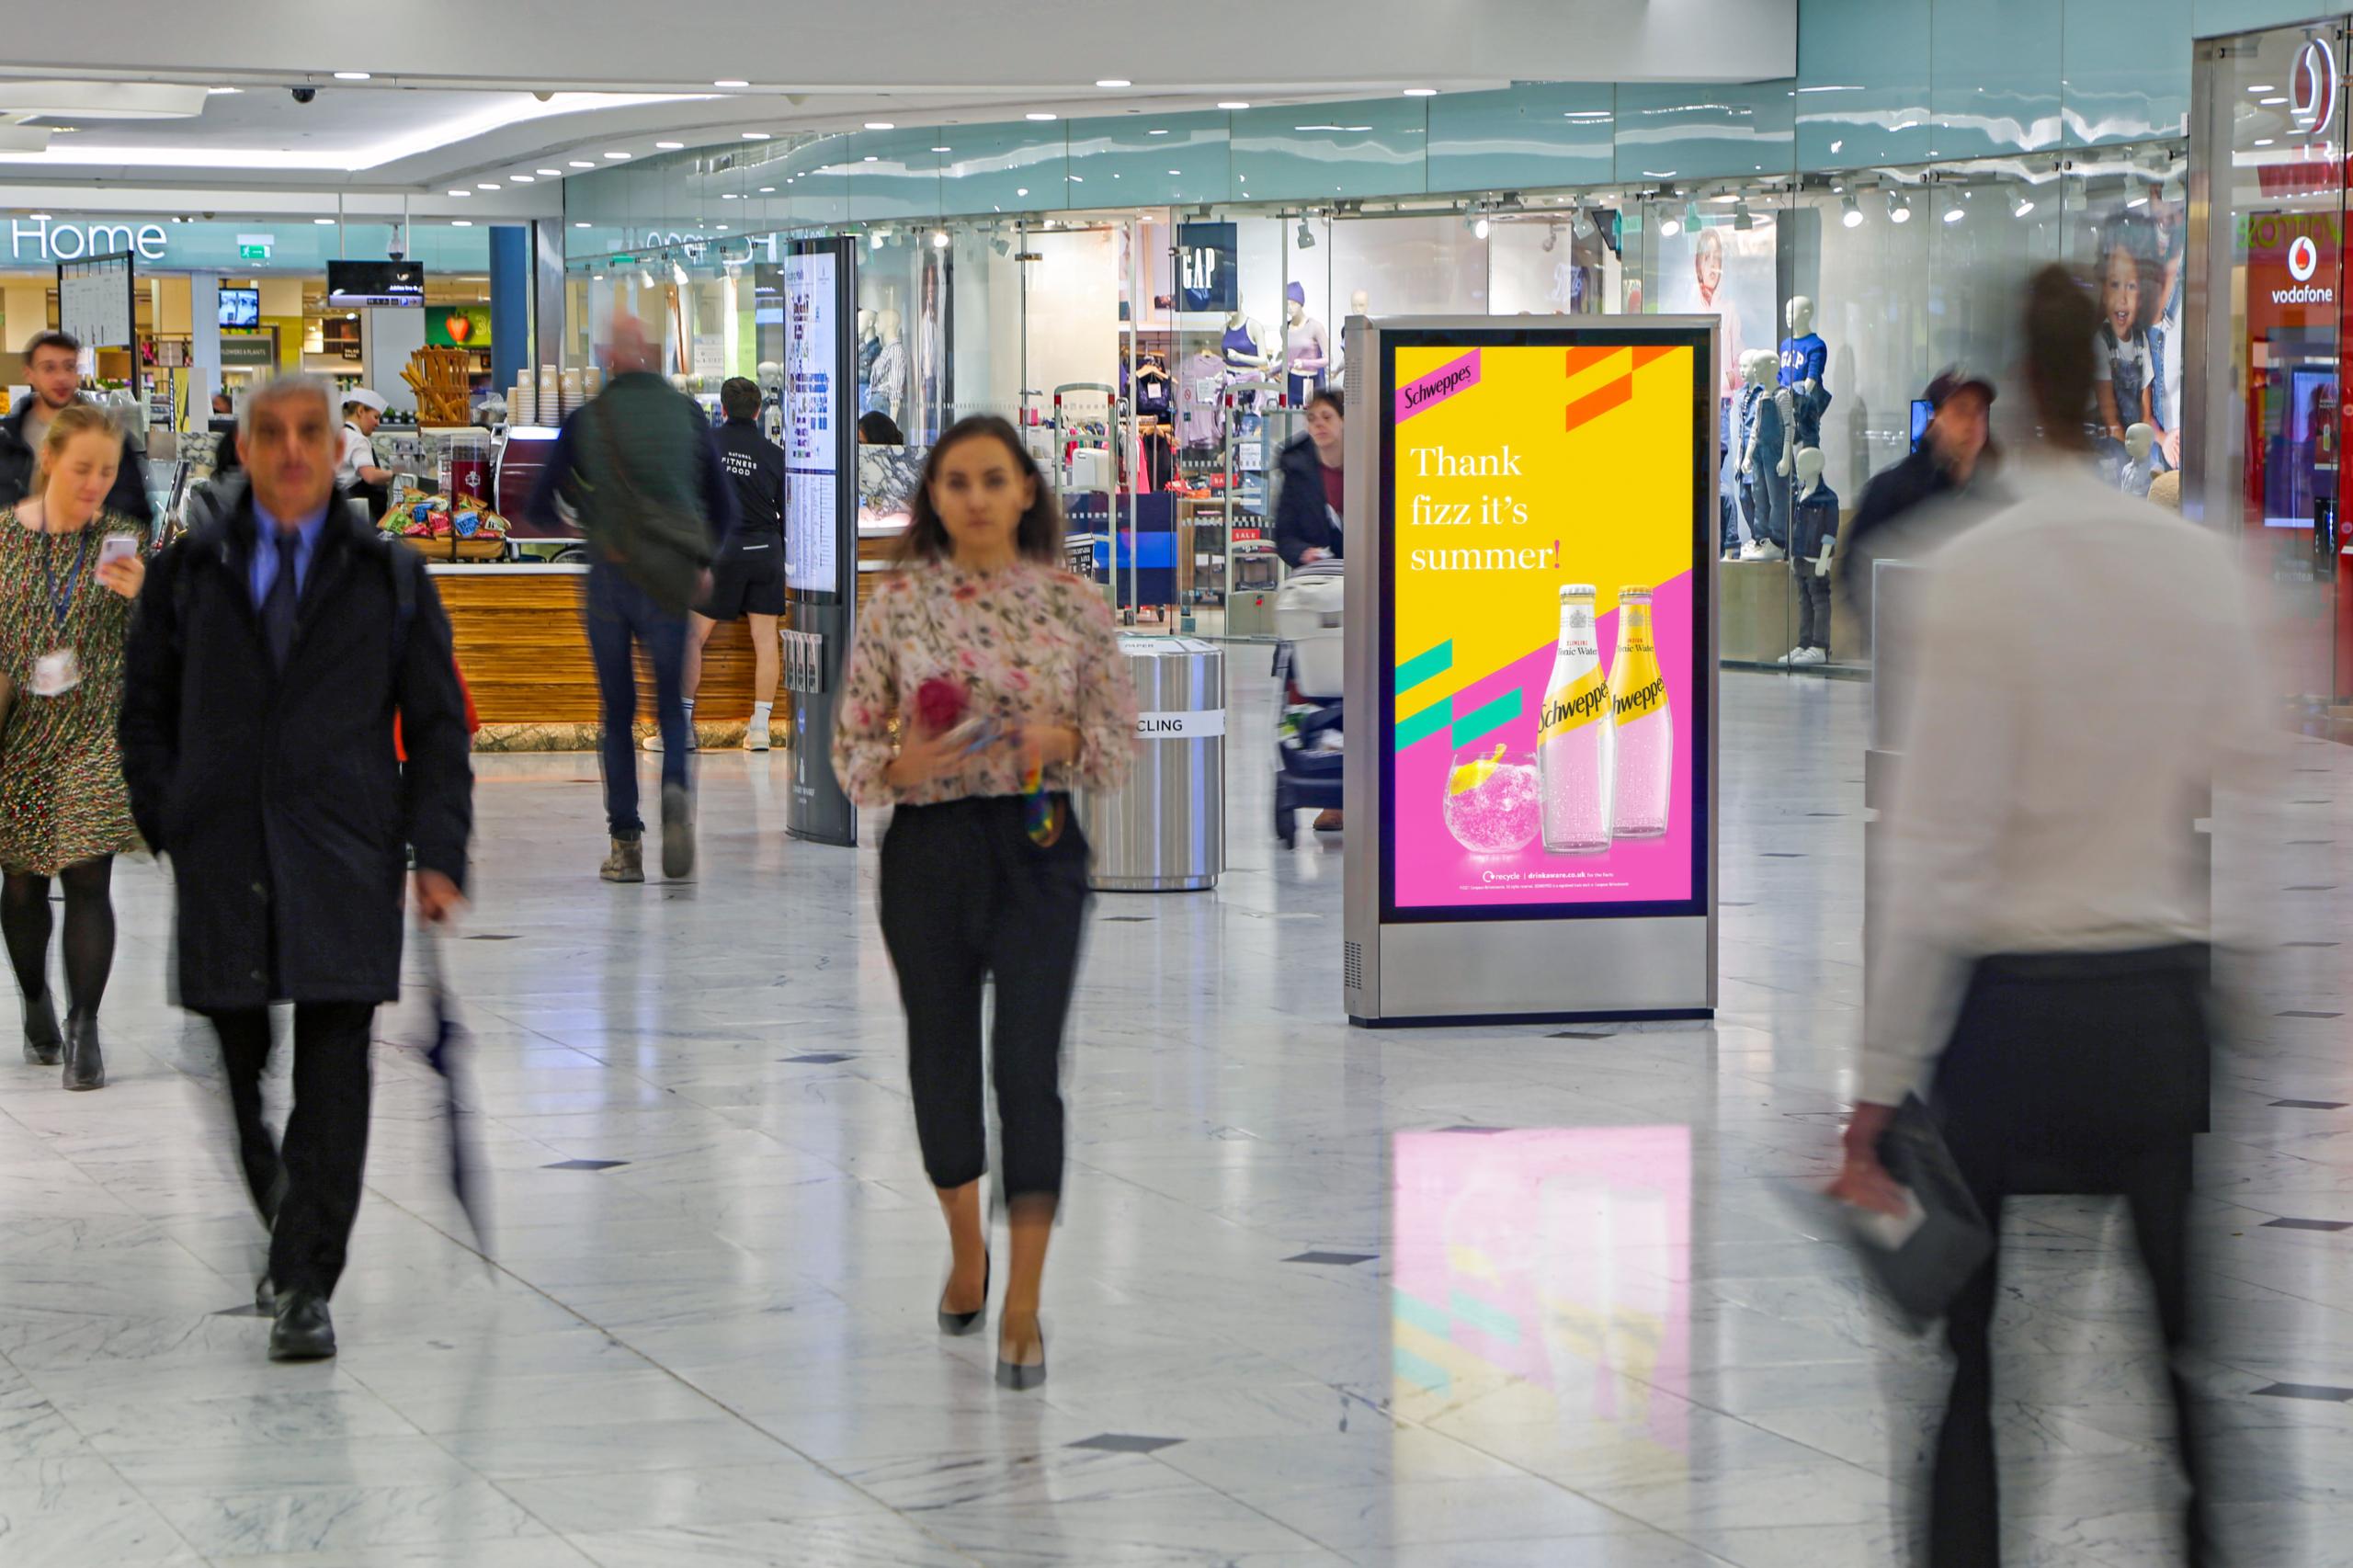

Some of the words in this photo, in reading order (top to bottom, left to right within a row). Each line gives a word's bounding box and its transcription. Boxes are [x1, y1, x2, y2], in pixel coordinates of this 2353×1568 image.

[12, 219, 167, 259] Home
[1183, 247, 1216, 289] GAP
[2272, 284, 2333, 303] vodafone
[1404, 365, 1472, 409] Schweppes
[721, 457, 757, 470] FITNESS
[726, 465, 750, 476] FOOD
[1410, 445, 1522, 476] Thank
[1410, 494, 1472, 525] fizz
[1481, 494, 1529, 525] it's
[1411, 540, 1560, 571] summer!
[1495, 871, 1520, 881] recycle
[1528, 870, 1586, 880] drinkaware.co.uk
